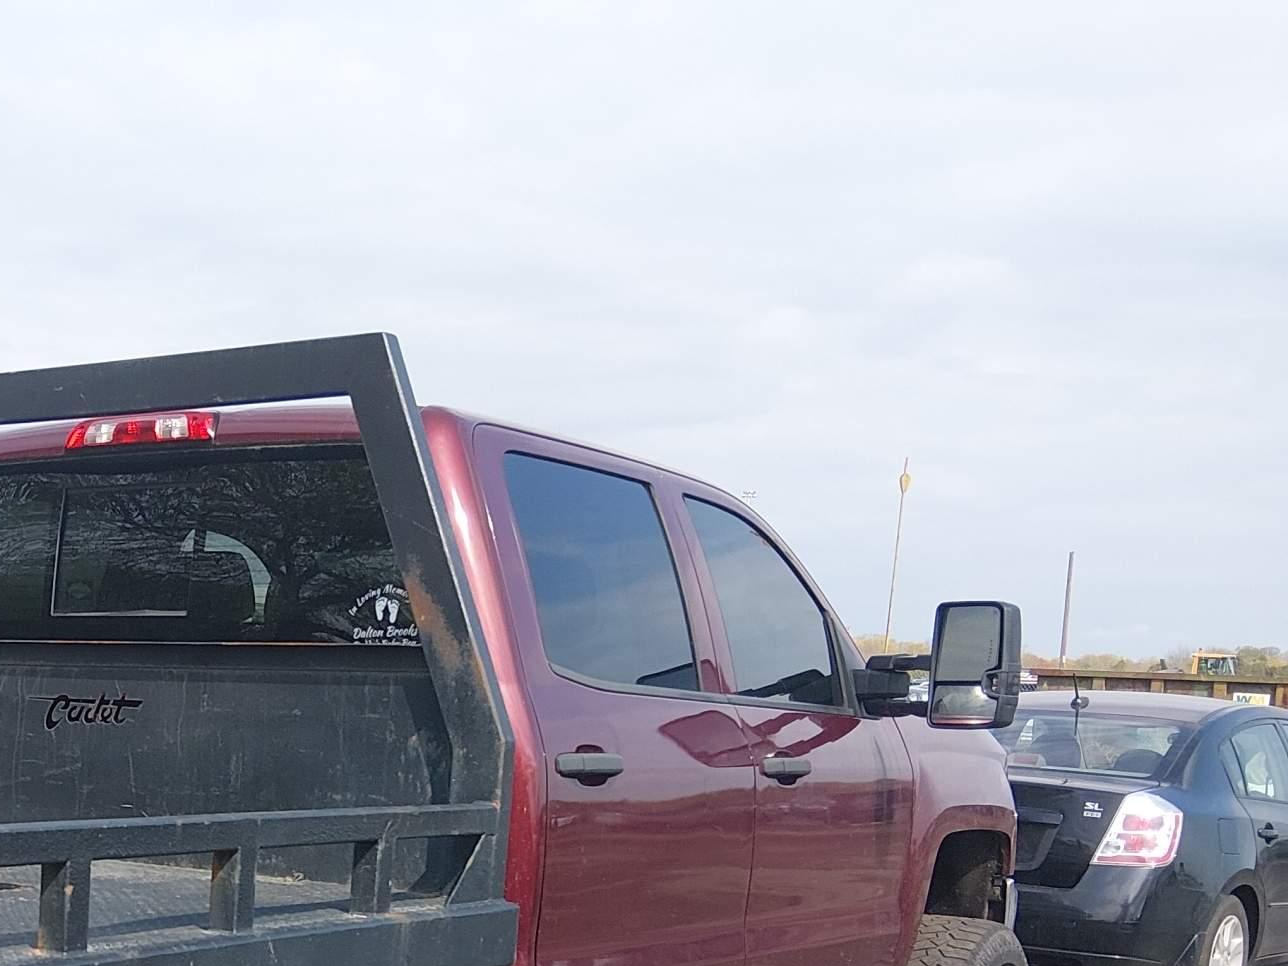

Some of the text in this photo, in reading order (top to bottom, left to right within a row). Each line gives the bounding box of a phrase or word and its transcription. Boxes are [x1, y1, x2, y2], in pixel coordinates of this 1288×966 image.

[356, 588, 382, 608] Loving
[353, 623, 419, 640] Dalton Brooks
[27, 692, 144, 731] Cadet
[1083, 801, 1104, 811] SL
